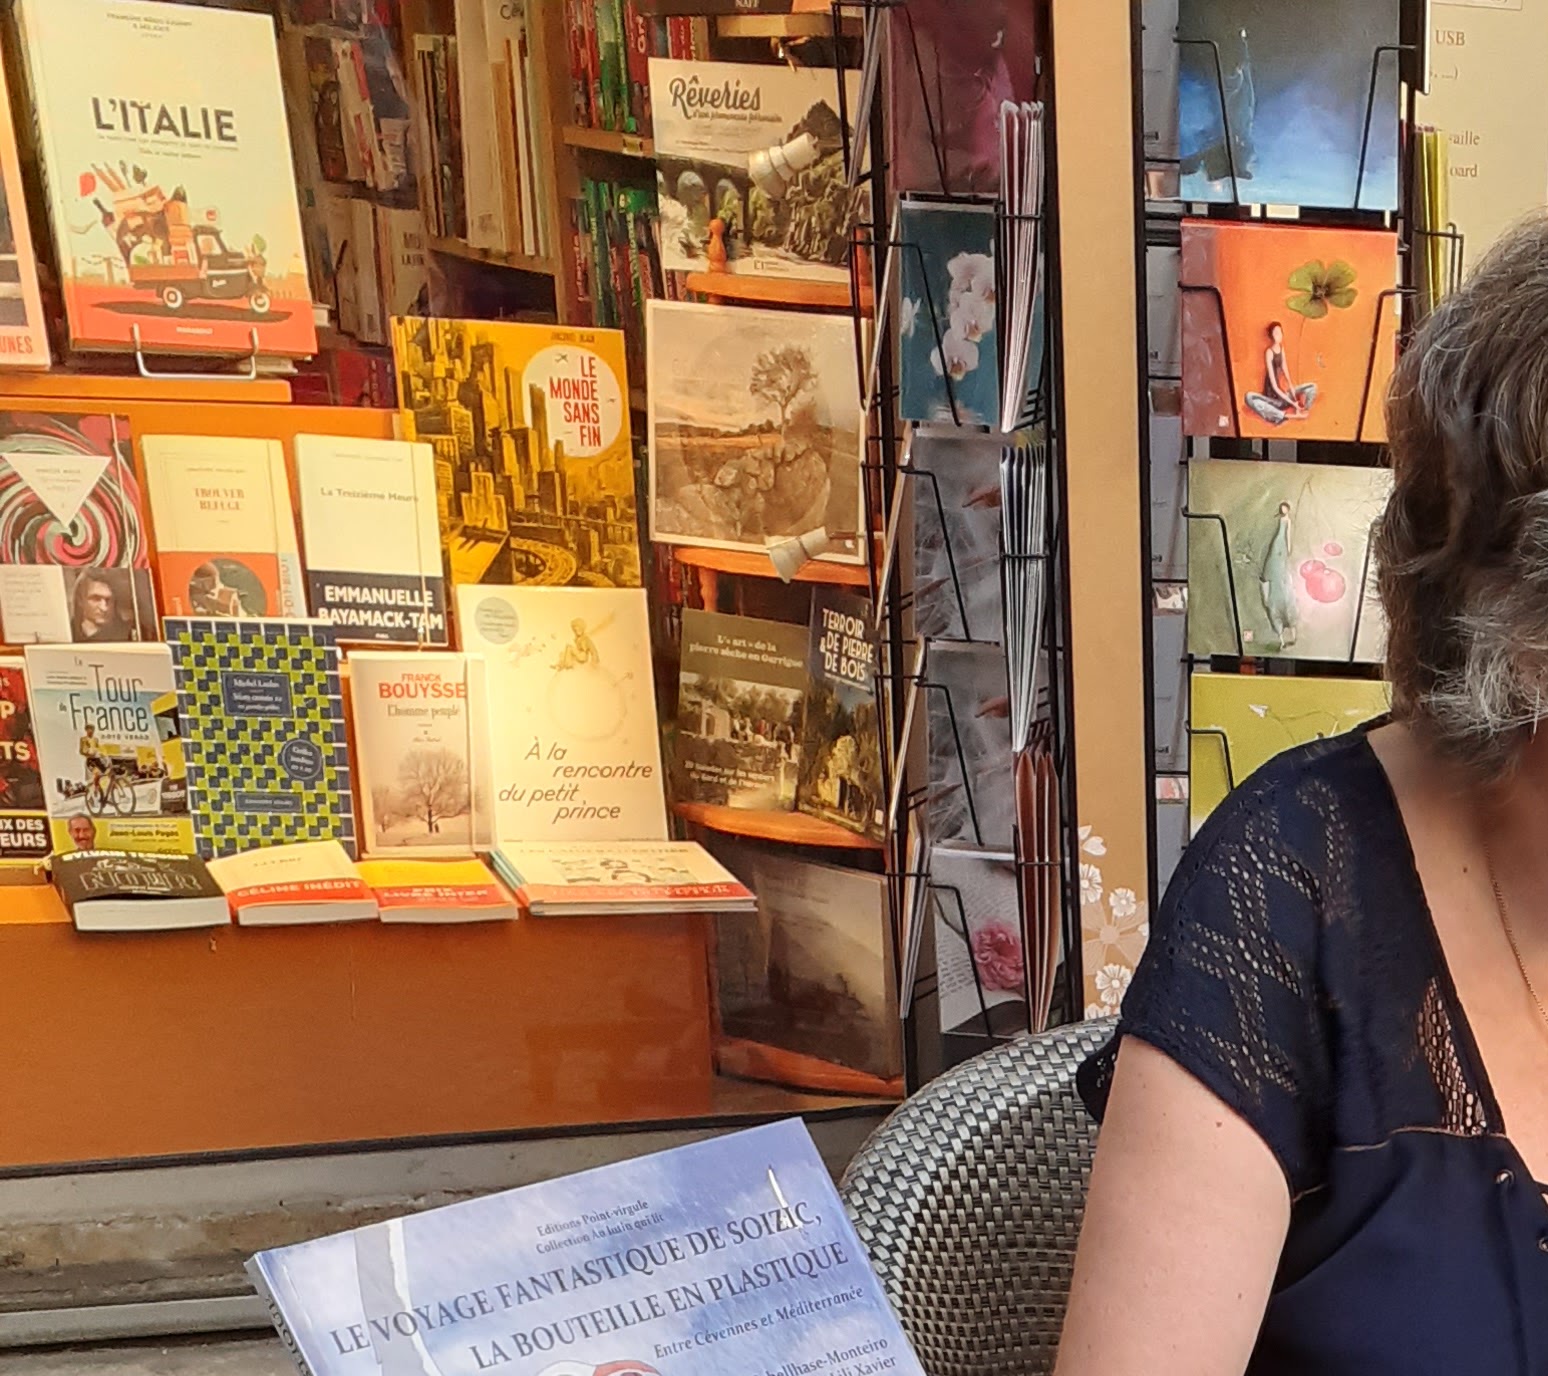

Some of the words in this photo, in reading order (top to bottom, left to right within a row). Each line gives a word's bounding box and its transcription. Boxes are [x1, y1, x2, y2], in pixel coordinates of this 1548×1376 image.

[1435, 30, 1466, 46] USB
[669, 75, 760, 120] Rêveries
[92, 97, 237, 142] L'ITALIE
[580, 355, 597, 378] LE
[549, 376, 599, 402] MONDE
[563, 401, 600, 424] SANS
[580, 425, 602, 447] FIN
[325, 585, 433, 608] EMMANUELLE
[318, 608, 443, 630] BAYAMACK-TAM
[822, 608, 865, 640] TERROIR
[826, 630, 840, 651] DE
[842, 636, 874, 664] PIERRE
[401, 672, 442, 683] FRANCK
[824, 653, 838, 673] DE
[840, 658, 866, 682] BOIS
[88, 663, 144, 704] Tour
[378, 681, 467, 699] BOUYSSE
[69, 692, 150, 732] France
[524, 735, 541, 761] À
[547, 741, 568, 761] la
[552, 760, 654, 779] rencontre
[498, 782, 527, 803] du
[526, 782, 582, 808] petit
[16, 819, 44, 831] DES
[552, 800, 621, 826] prince
[236, 882, 297, 898] CÉLINE
[303, 877, 361, 893] INÉDIT
[329, 1323, 371, 1355] LE
[370, 1289, 495, 1343] VOYAGE
[495, 1237, 686, 1310] FANTASTIQUE
[685, 1224, 727, 1257] DE
[726, 1201, 822, 1245] SOIZIC,
[469, 1340, 512, 1371] LA
[511, 1294, 666, 1358] BOUTEILLE
[665, 1282, 706, 1314] EN
[706, 1241, 849, 1302] PLASTIQUE
[653, 1337, 692, 1360] Entre
[693, 1317, 759, 1349] Cévennes
[760, 1313, 775, 1328] et
[775, 1284, 865, 1323] Méditerranée
